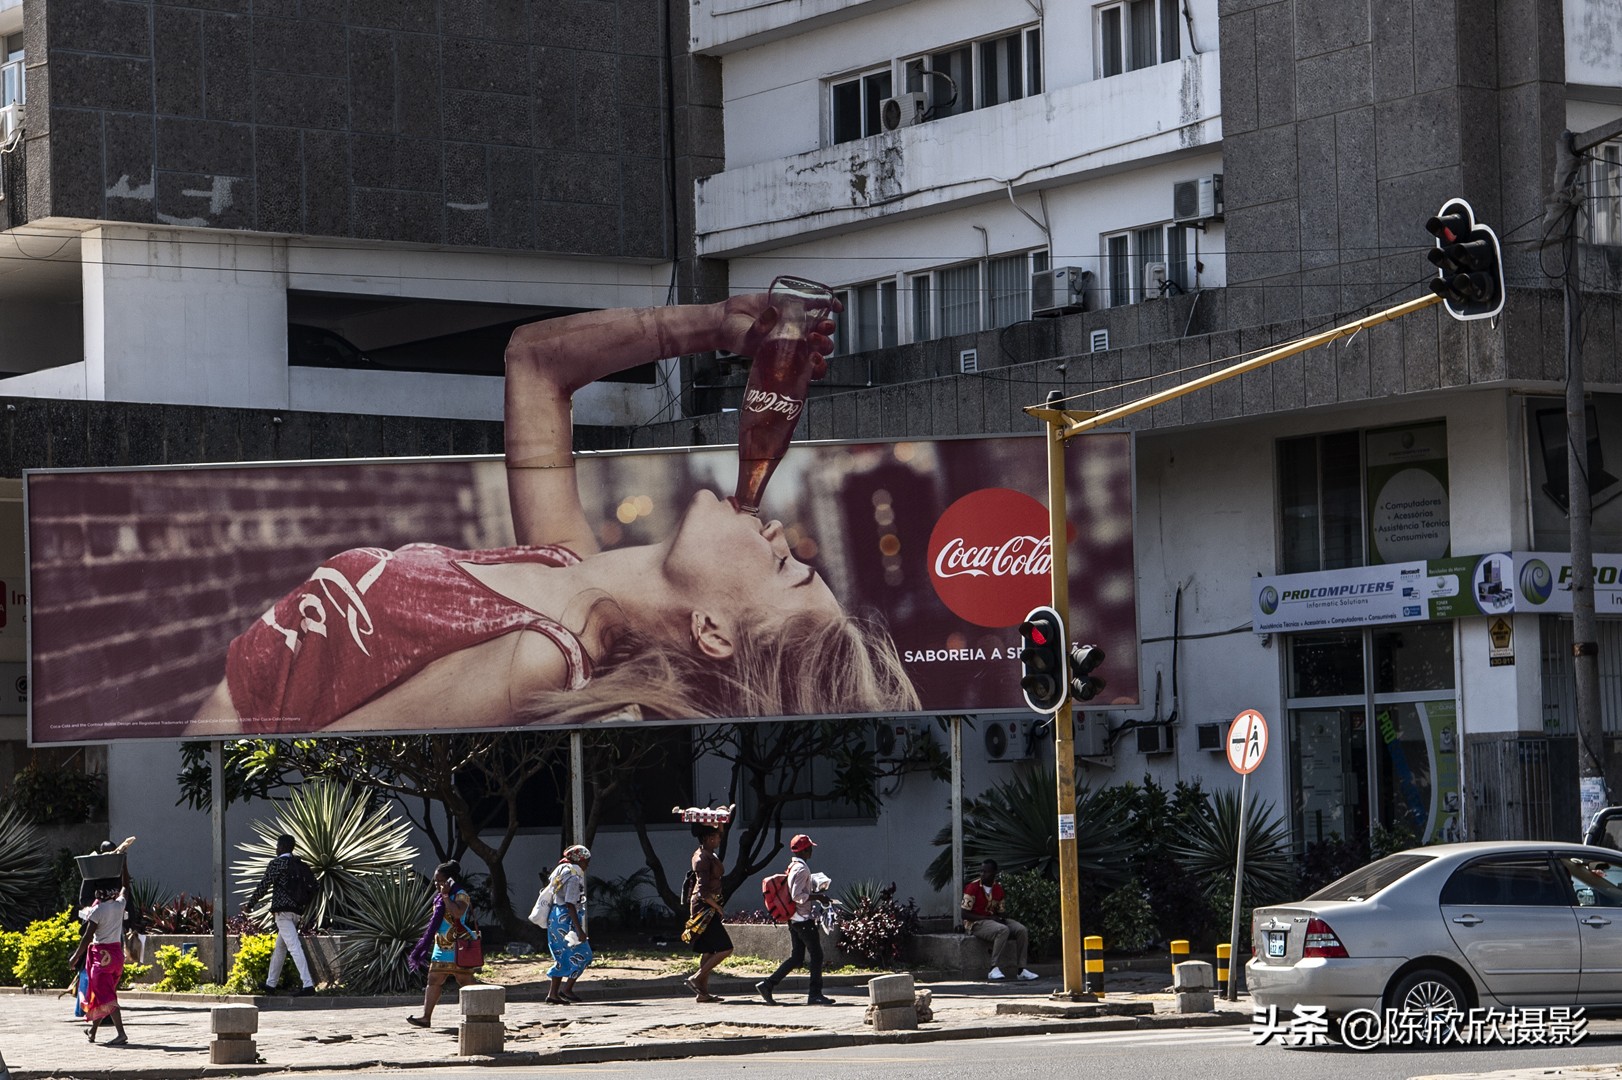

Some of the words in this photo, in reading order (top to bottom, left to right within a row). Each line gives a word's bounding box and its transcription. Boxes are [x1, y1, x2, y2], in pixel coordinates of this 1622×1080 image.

[1385, 498, 1441, 510] Computadores
[934, 535, 1053, 578] Coca-Cola
[1281, 581, 1394, 601] PROCOMPUTERS
[1306, 600, 1338, 608] Informatic
[1339, 598, 1369, 606] Solutions
[904, 648, 986, 663] SABOREIA
[990, 648, 1002, 660] A
